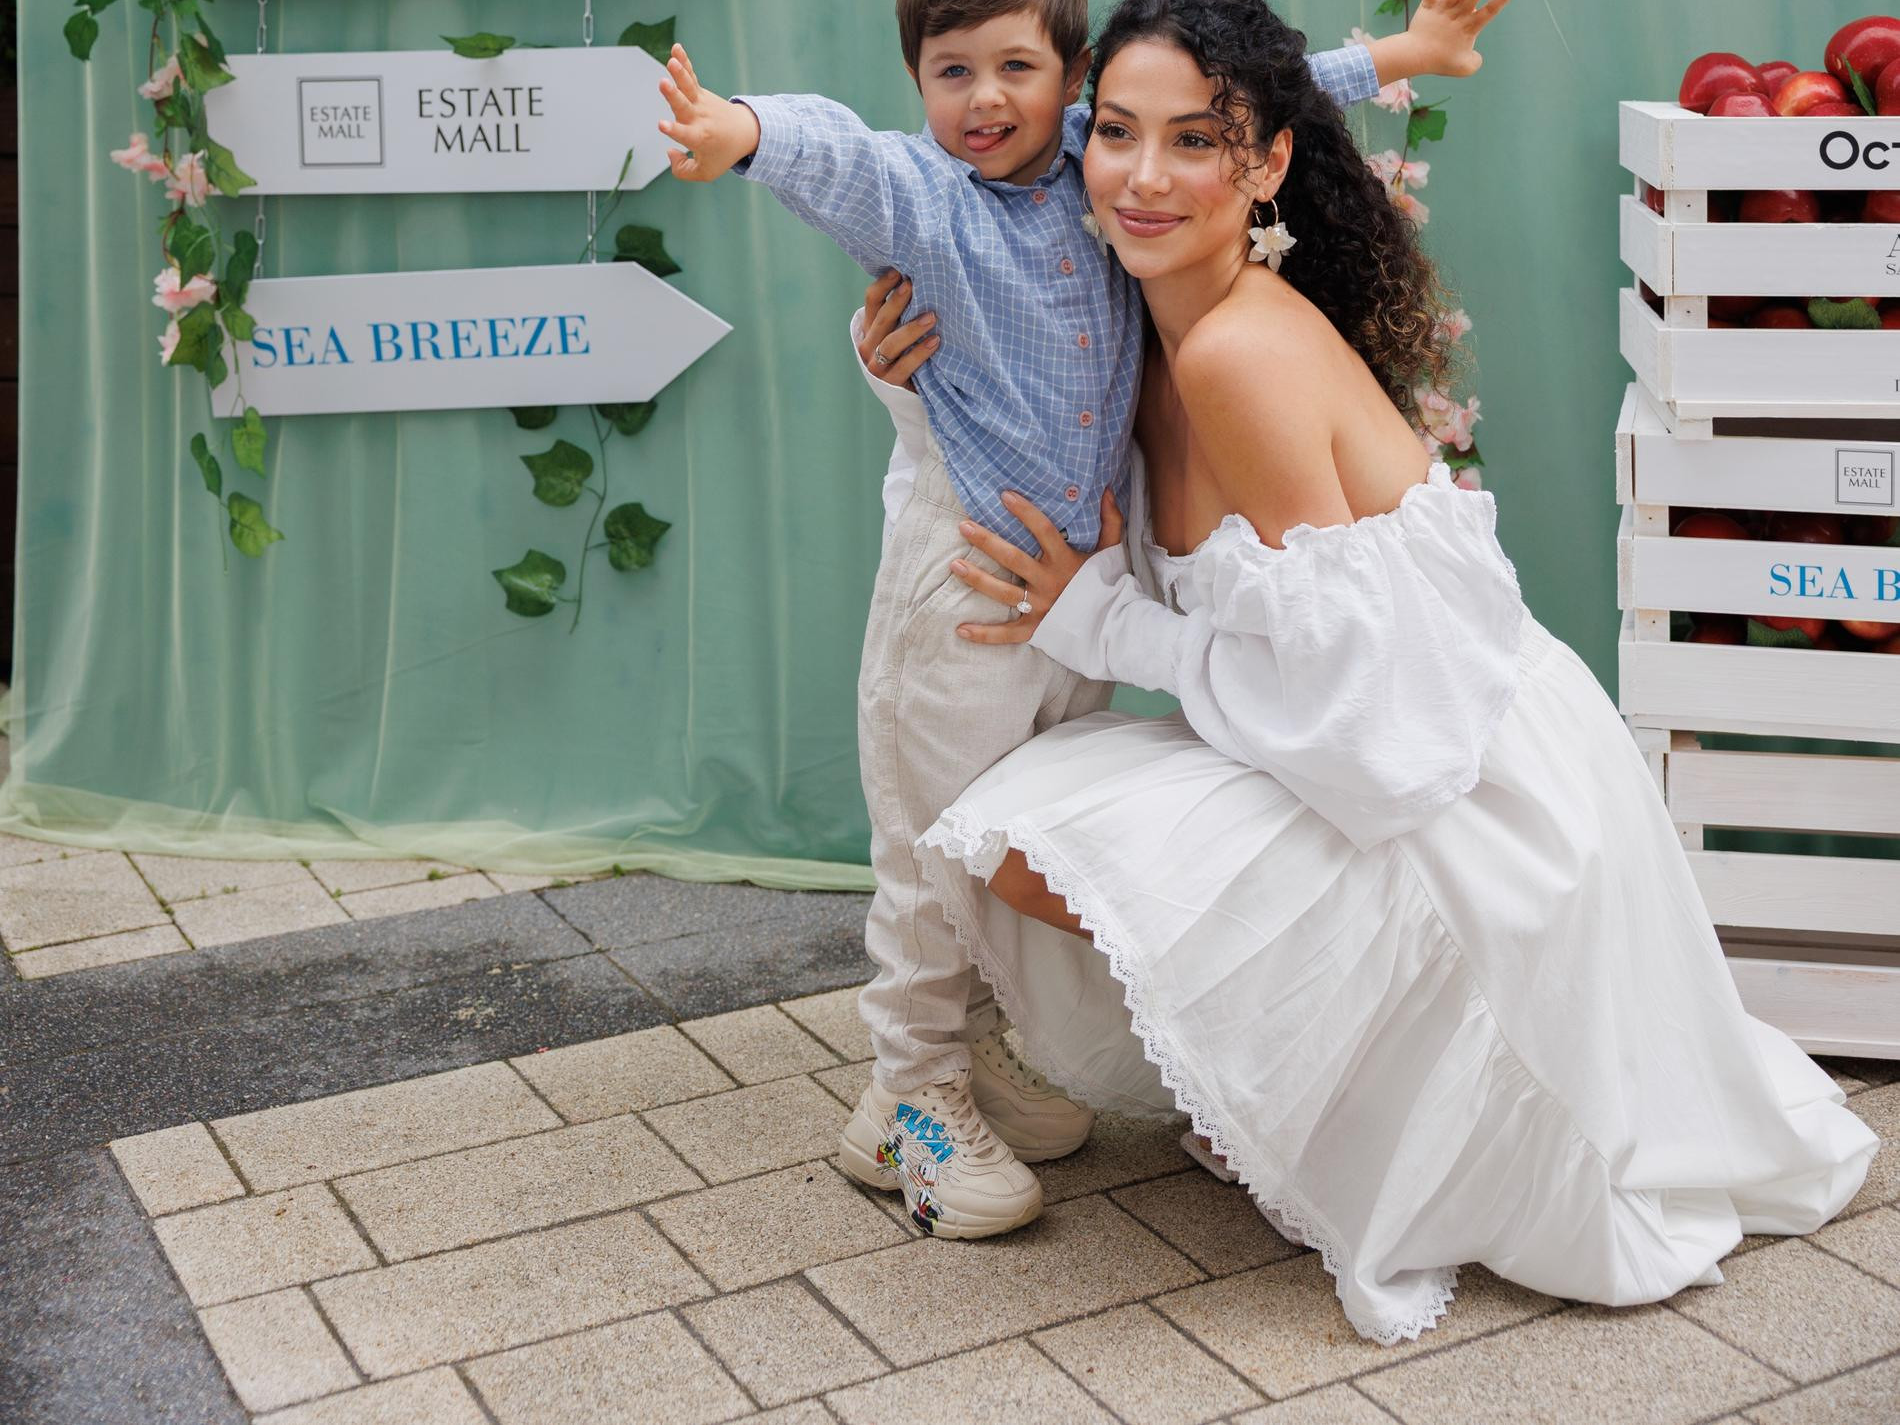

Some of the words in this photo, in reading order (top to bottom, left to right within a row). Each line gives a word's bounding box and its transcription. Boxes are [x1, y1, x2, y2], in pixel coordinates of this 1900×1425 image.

[310, 105, 372, 123] ESTATE
[417, 86, 545, 119] ESTATE
[317, 124, 366, 140] MALL
[433, 122, 531, 154] MALL
[251, 324, 355, 369] SEA
[366, 314, 591, 364] BREEZE
[1843, 466, 1886, 479] ESTATE
[1848, 478, 1881, 489] MALL
[1769, 563, 1859, 600] SEA
[896, 1102, 955, 1164] FLASH
